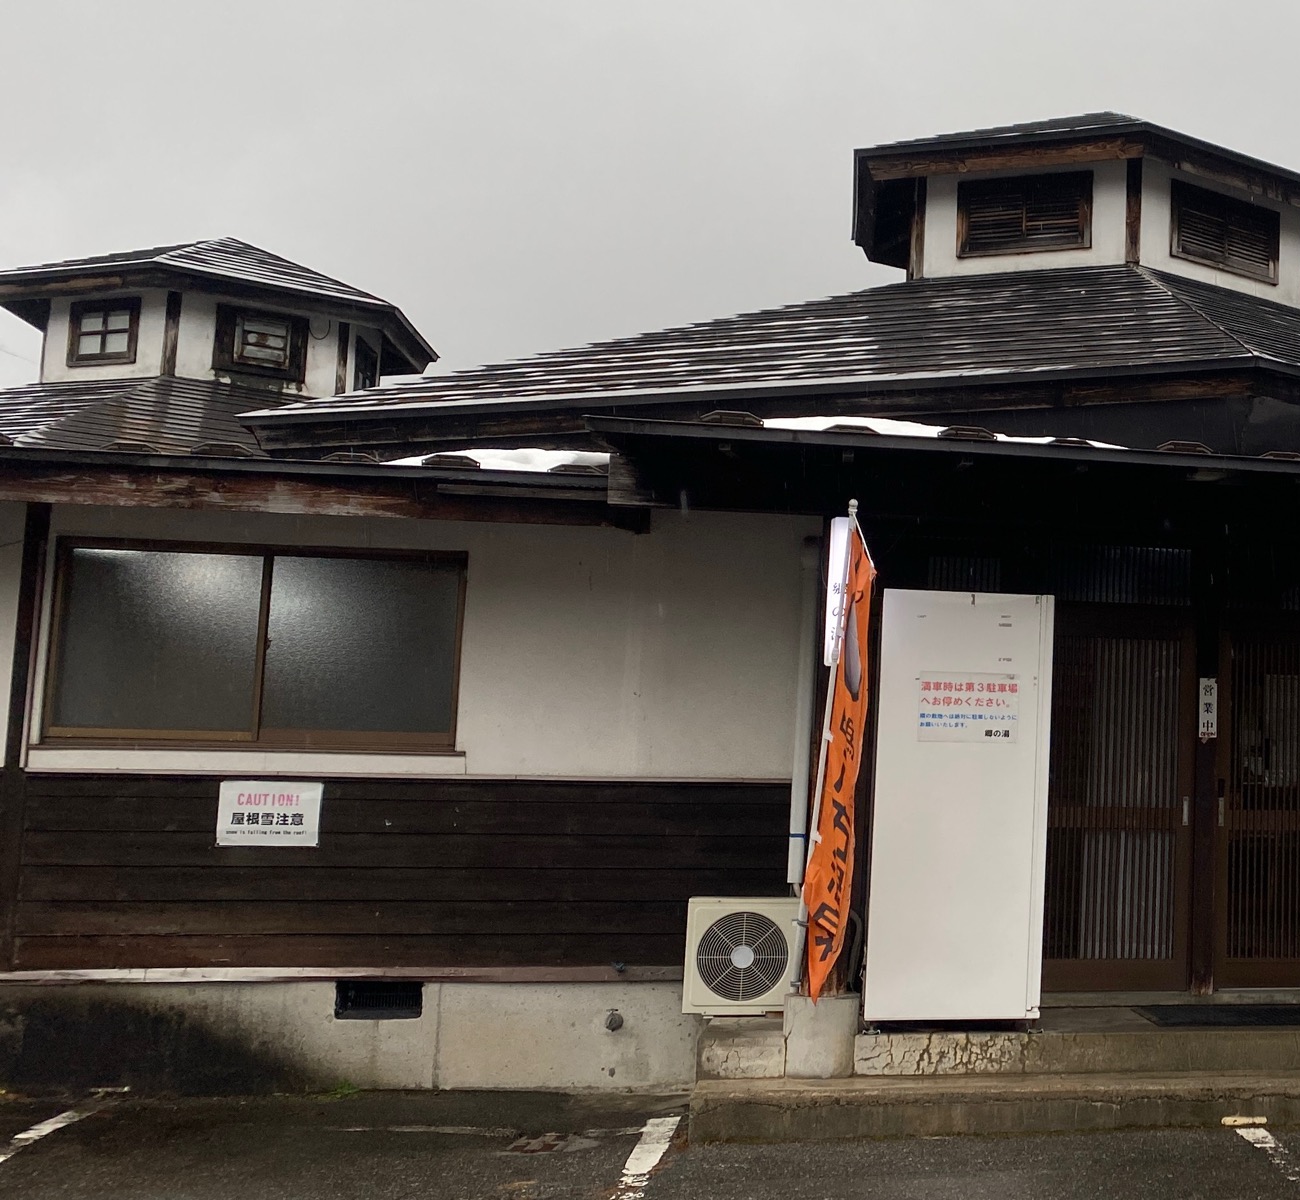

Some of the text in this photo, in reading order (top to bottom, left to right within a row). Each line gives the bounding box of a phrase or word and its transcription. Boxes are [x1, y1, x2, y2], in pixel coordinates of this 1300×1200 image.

[920, 681, 1018, 694] 満車時は第3駐車場
[920, 696, 1010, 708] へお停めください。
[1203, 684, 1214, 732] 営業中
[984, 729, 1010, 738] 郷の湯
[237, 793, 300, 806] CAUTION!
[230, 812, 304, 826] 屋根雪注意
